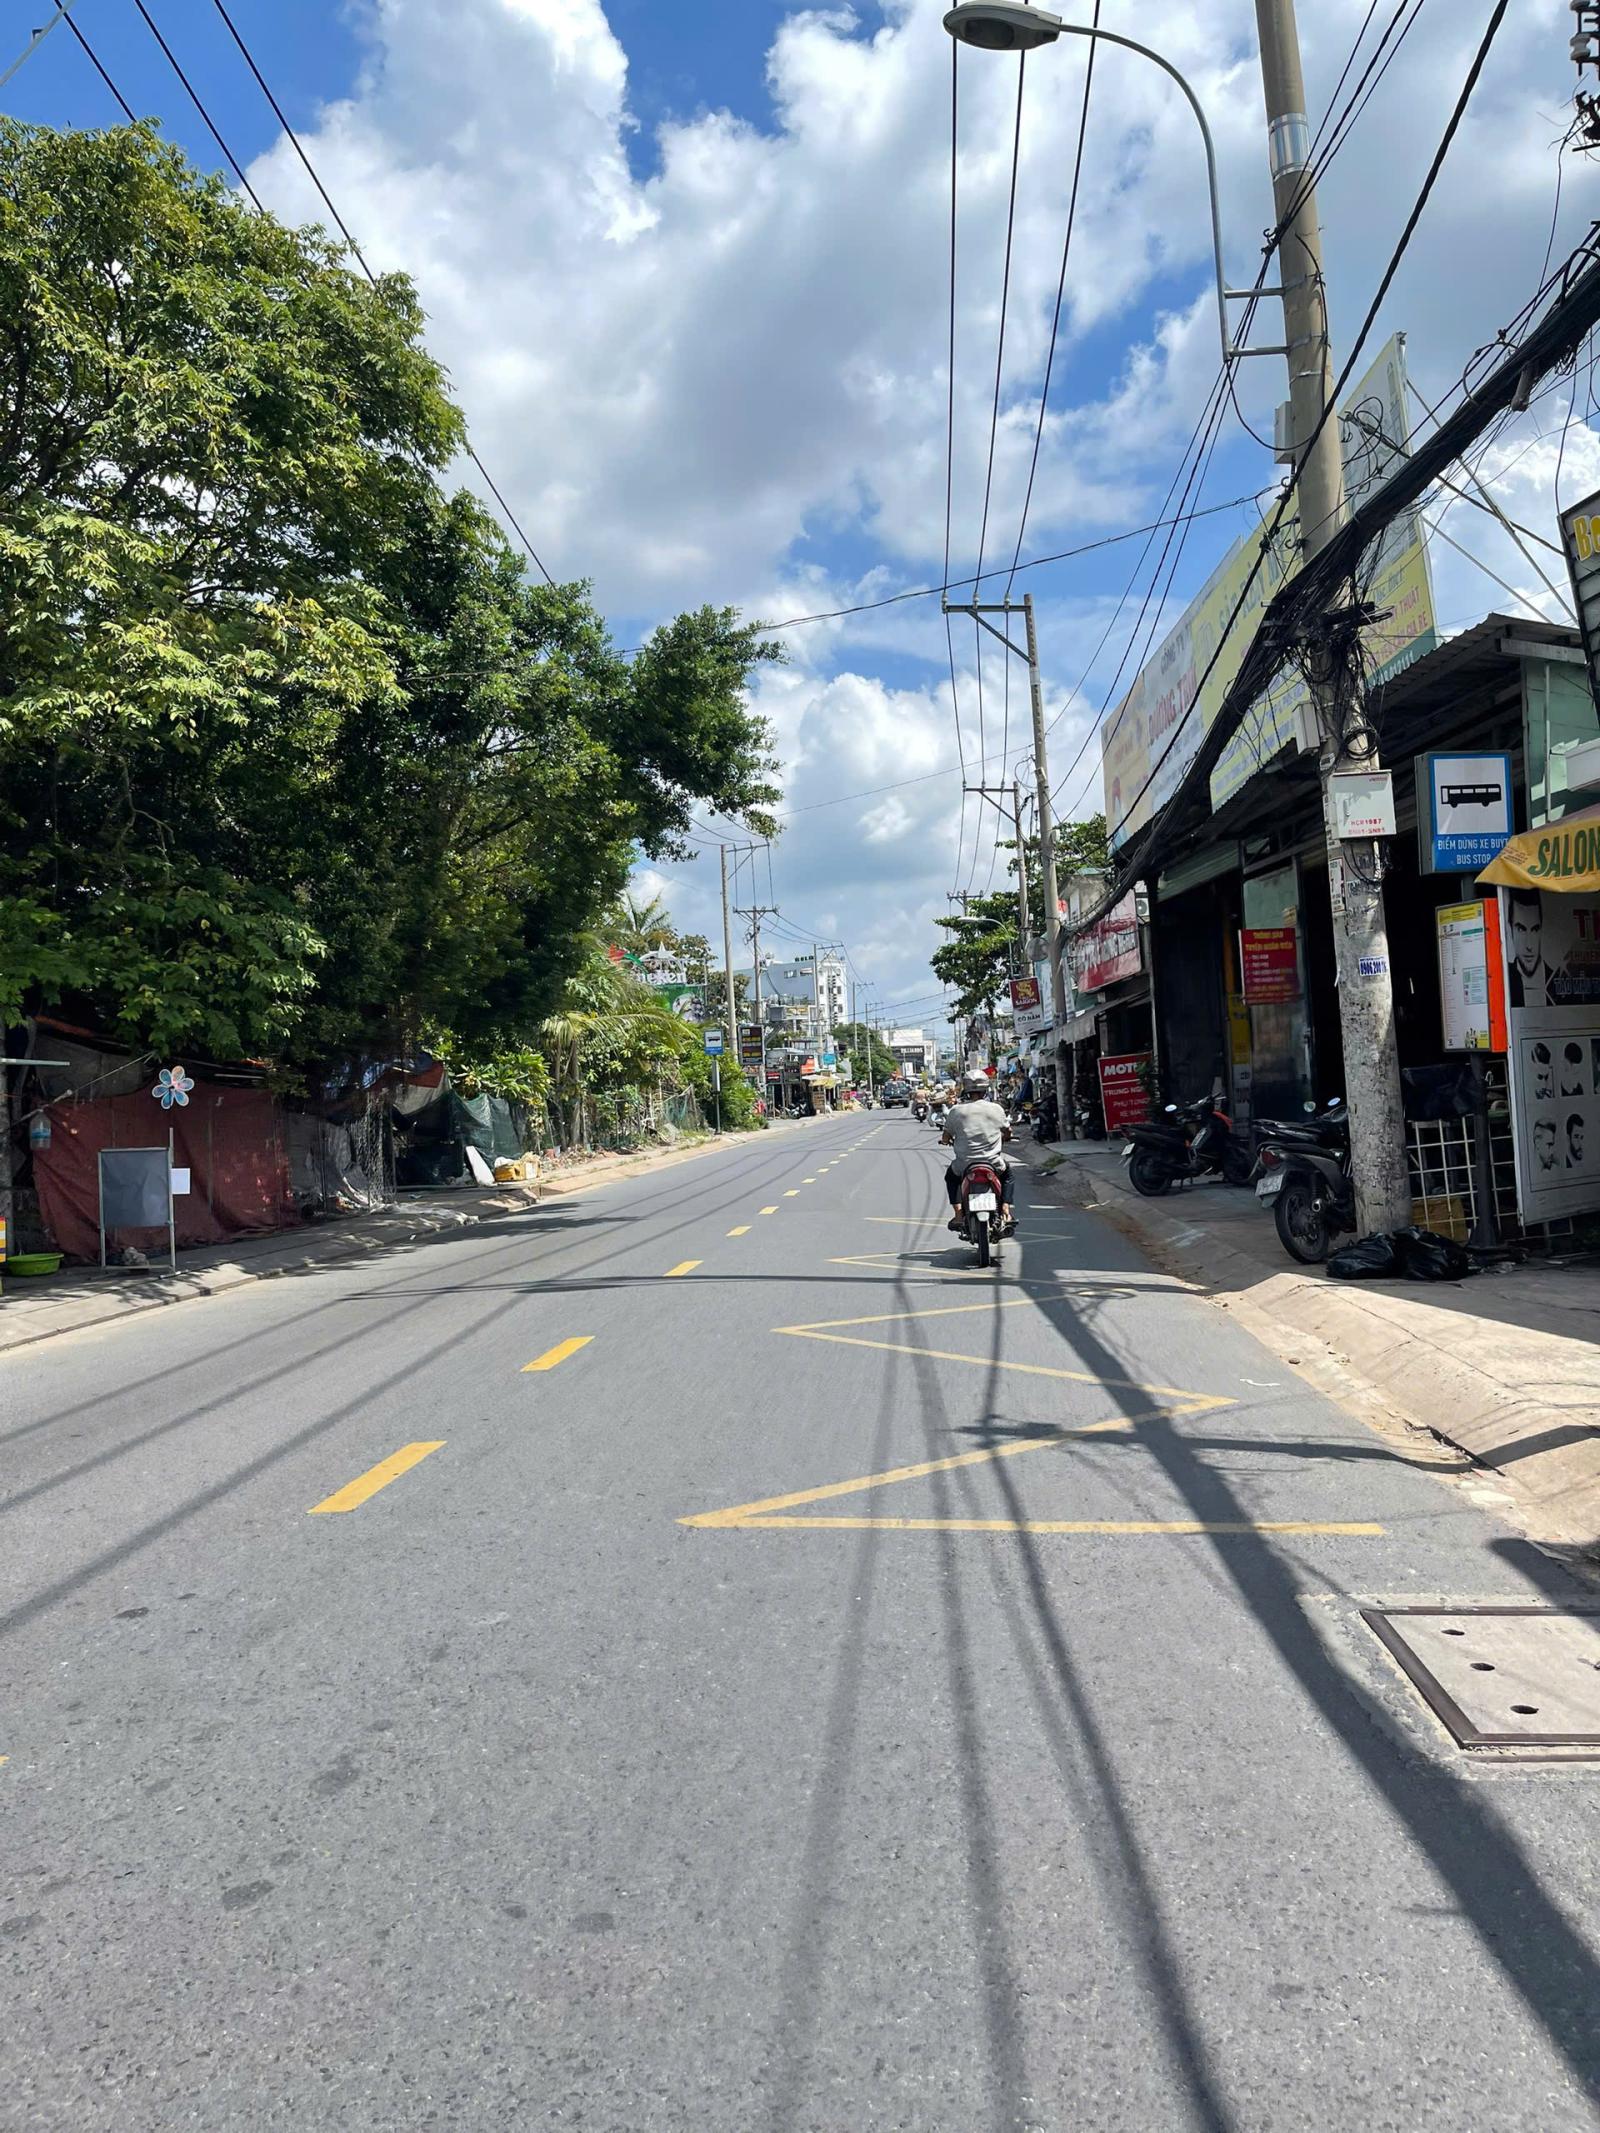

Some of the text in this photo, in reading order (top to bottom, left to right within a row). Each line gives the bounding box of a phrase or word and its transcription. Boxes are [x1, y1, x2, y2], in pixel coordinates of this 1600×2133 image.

[1479, 839, 1490, 850] XE
[1456, 854, 1472, 865] BUS
[1472, 853, 1491, 864] STOP
